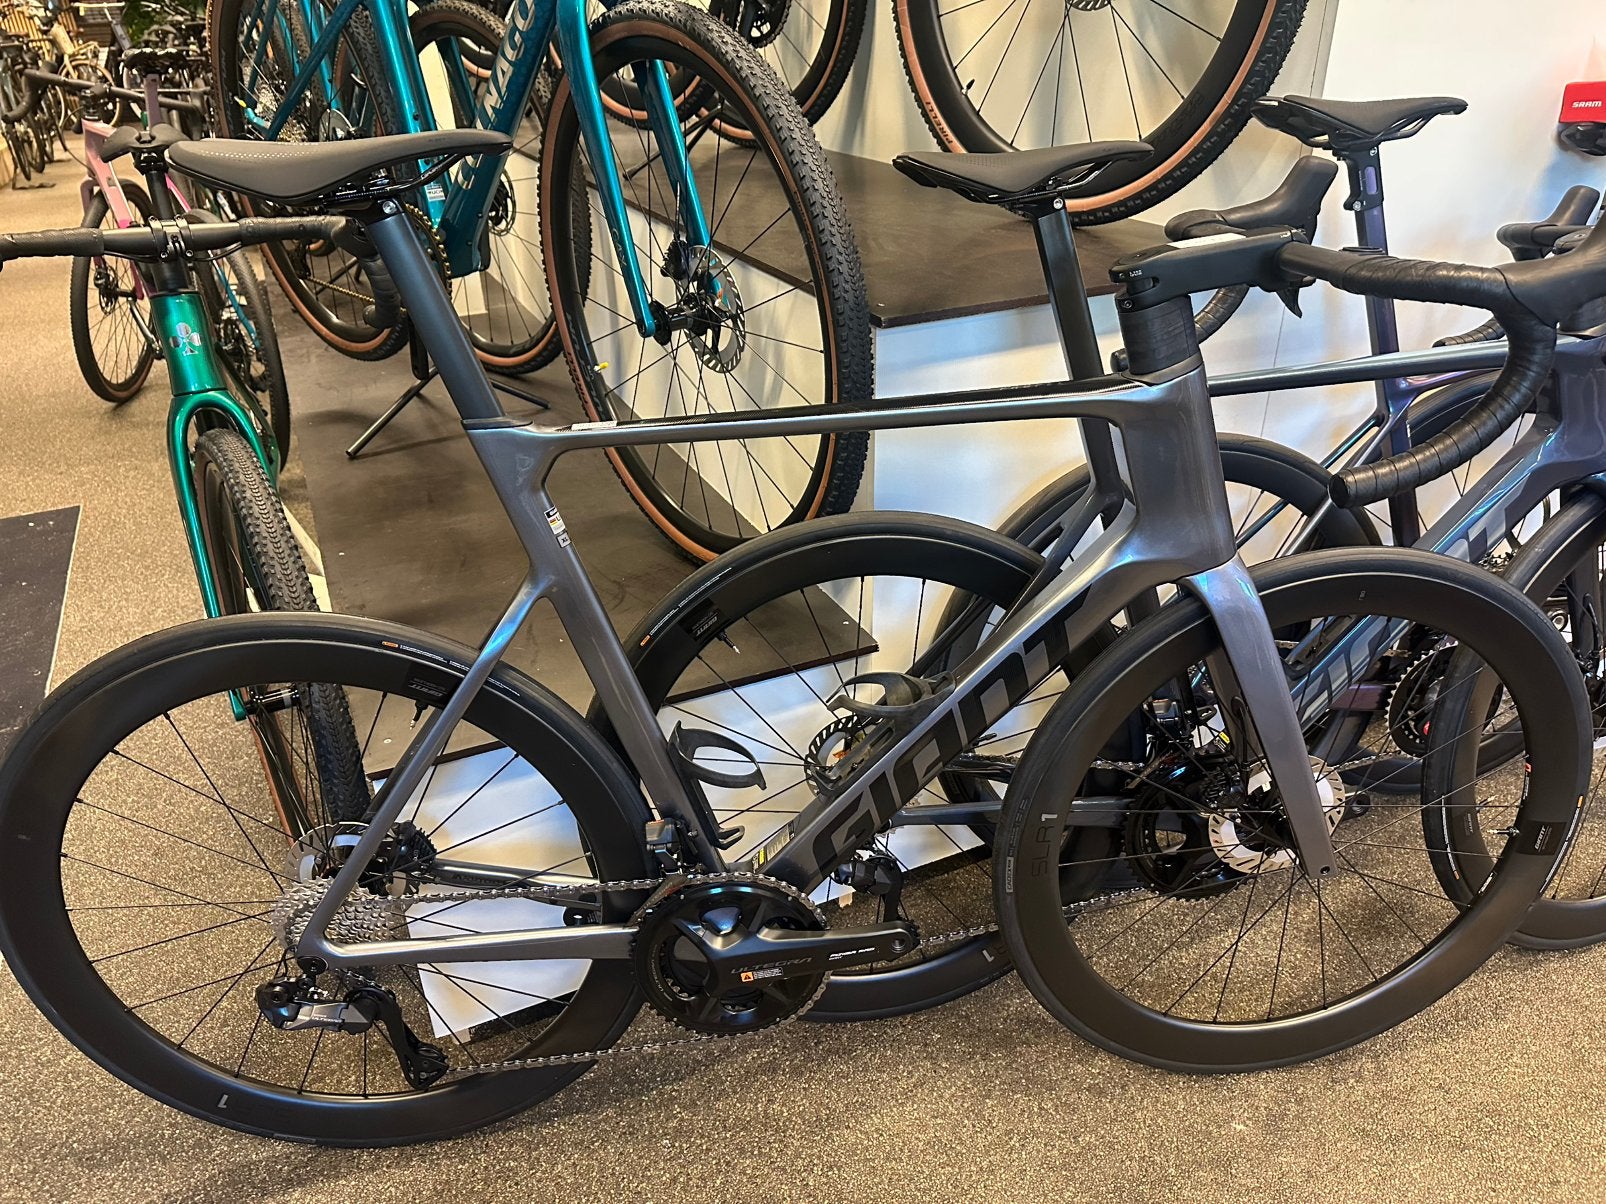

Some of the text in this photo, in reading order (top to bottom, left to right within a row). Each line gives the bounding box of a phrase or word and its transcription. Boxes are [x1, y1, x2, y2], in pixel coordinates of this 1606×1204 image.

[925, 101, 953, 144] PIRELLI
[1572, 100, 1602, 108] SRAM
[812, 583, 1092, 880] GIANT
